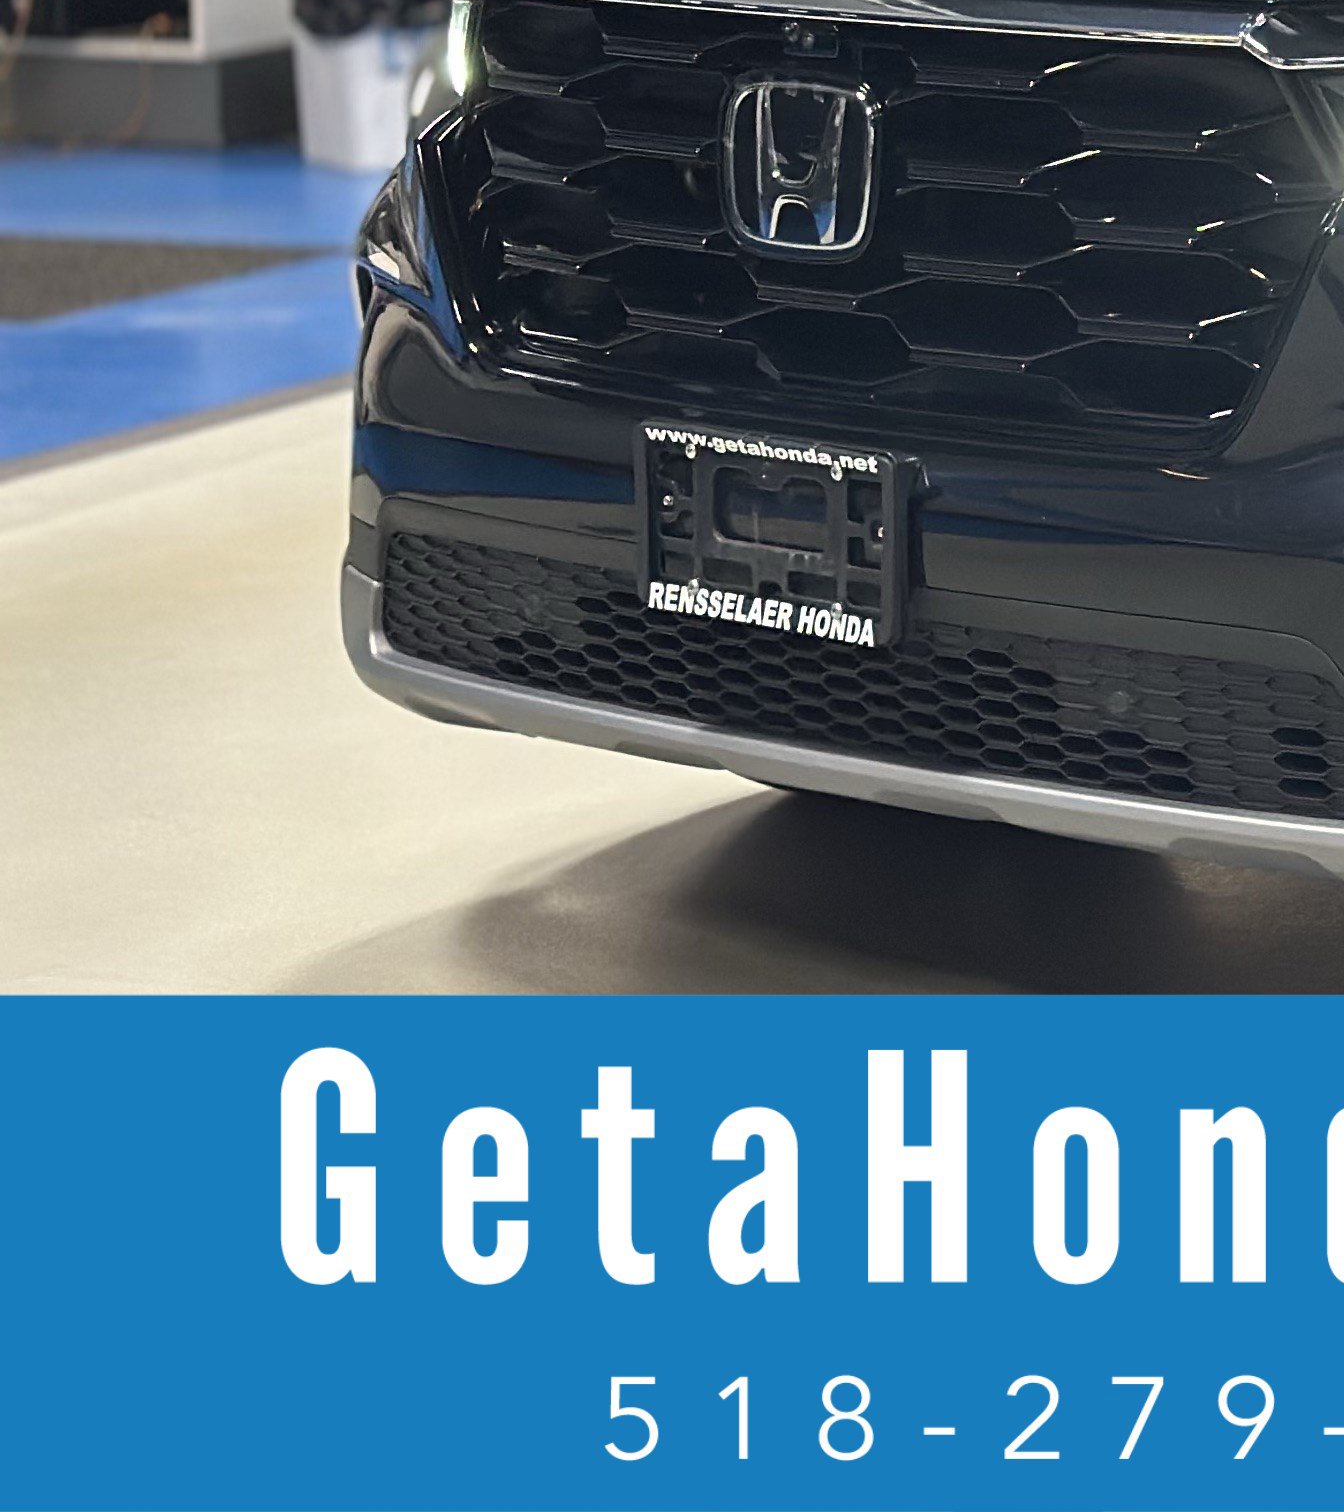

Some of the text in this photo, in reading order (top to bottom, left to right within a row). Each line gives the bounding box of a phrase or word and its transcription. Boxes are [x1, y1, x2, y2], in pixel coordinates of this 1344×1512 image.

[645, 426, 878, 474] www.getahonda.net
[648, 581, 875, 648] RENSSELAER HONDA
